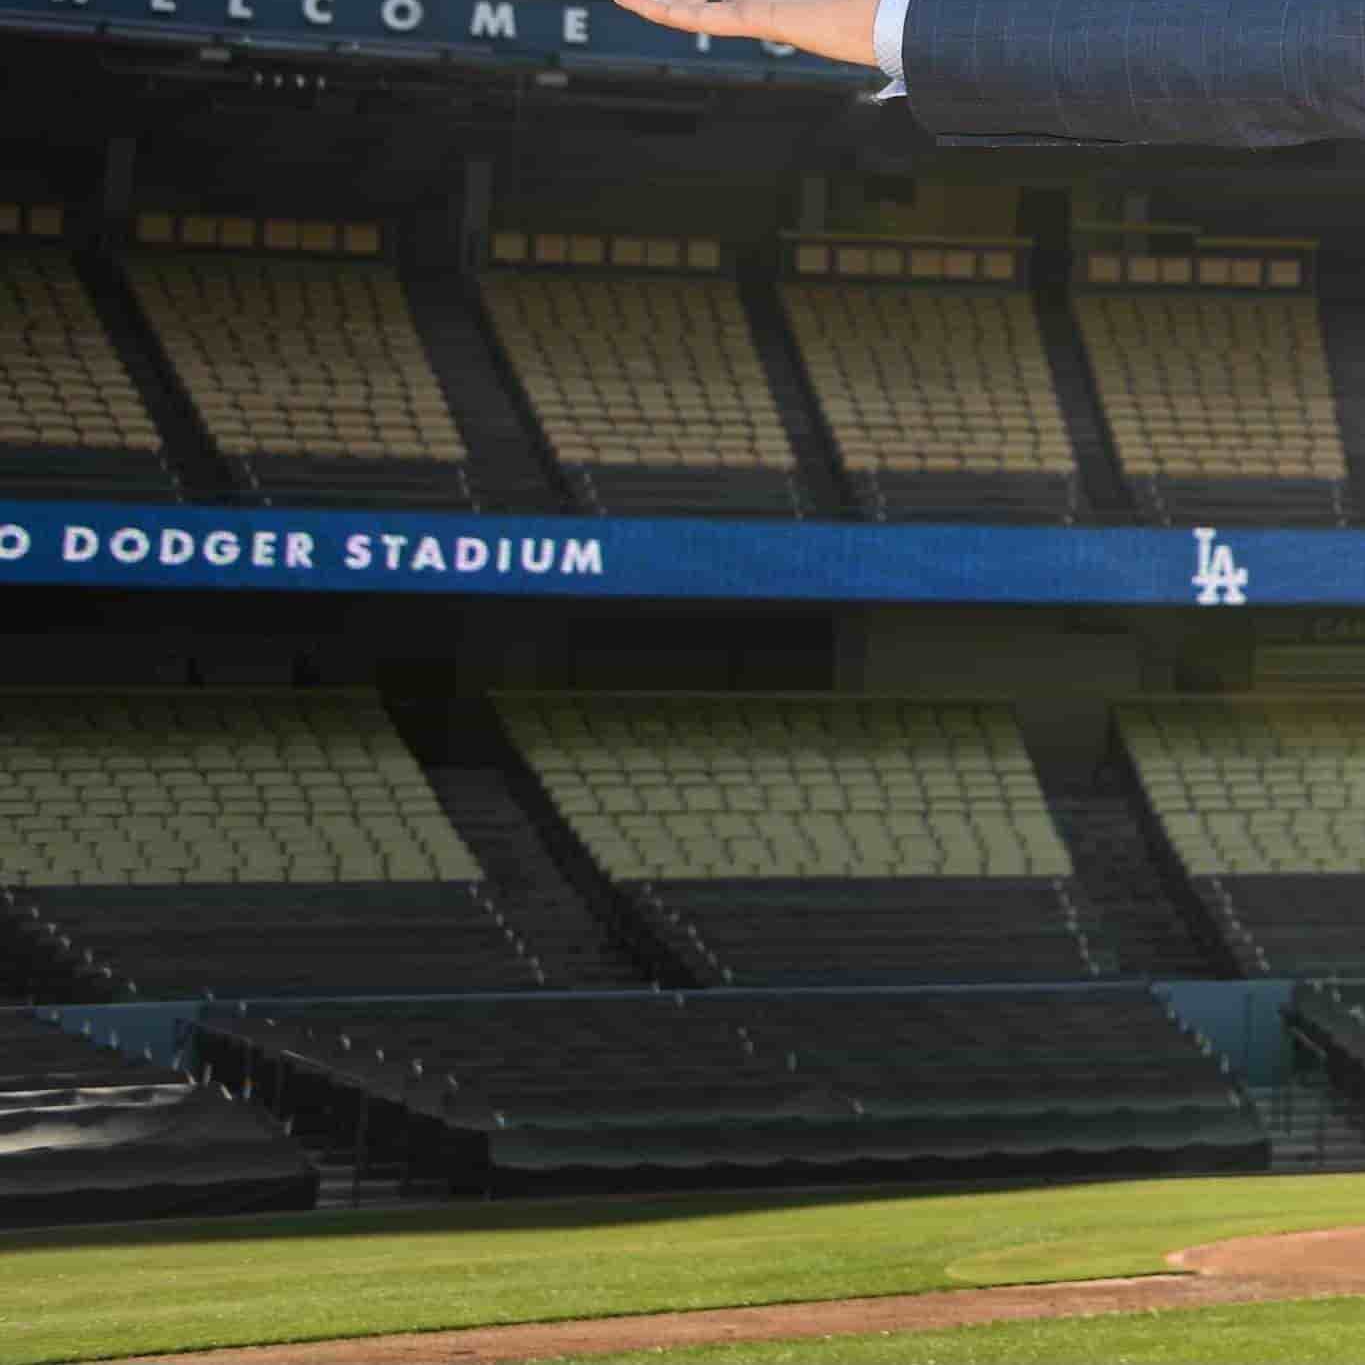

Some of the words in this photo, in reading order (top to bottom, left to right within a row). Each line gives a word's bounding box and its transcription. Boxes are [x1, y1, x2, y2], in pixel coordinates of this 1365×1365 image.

[62, 526, 314, 568] DODGER
[344, 534, 603, 574] STADIUM
[1192, 527, 1248, 605] LA
